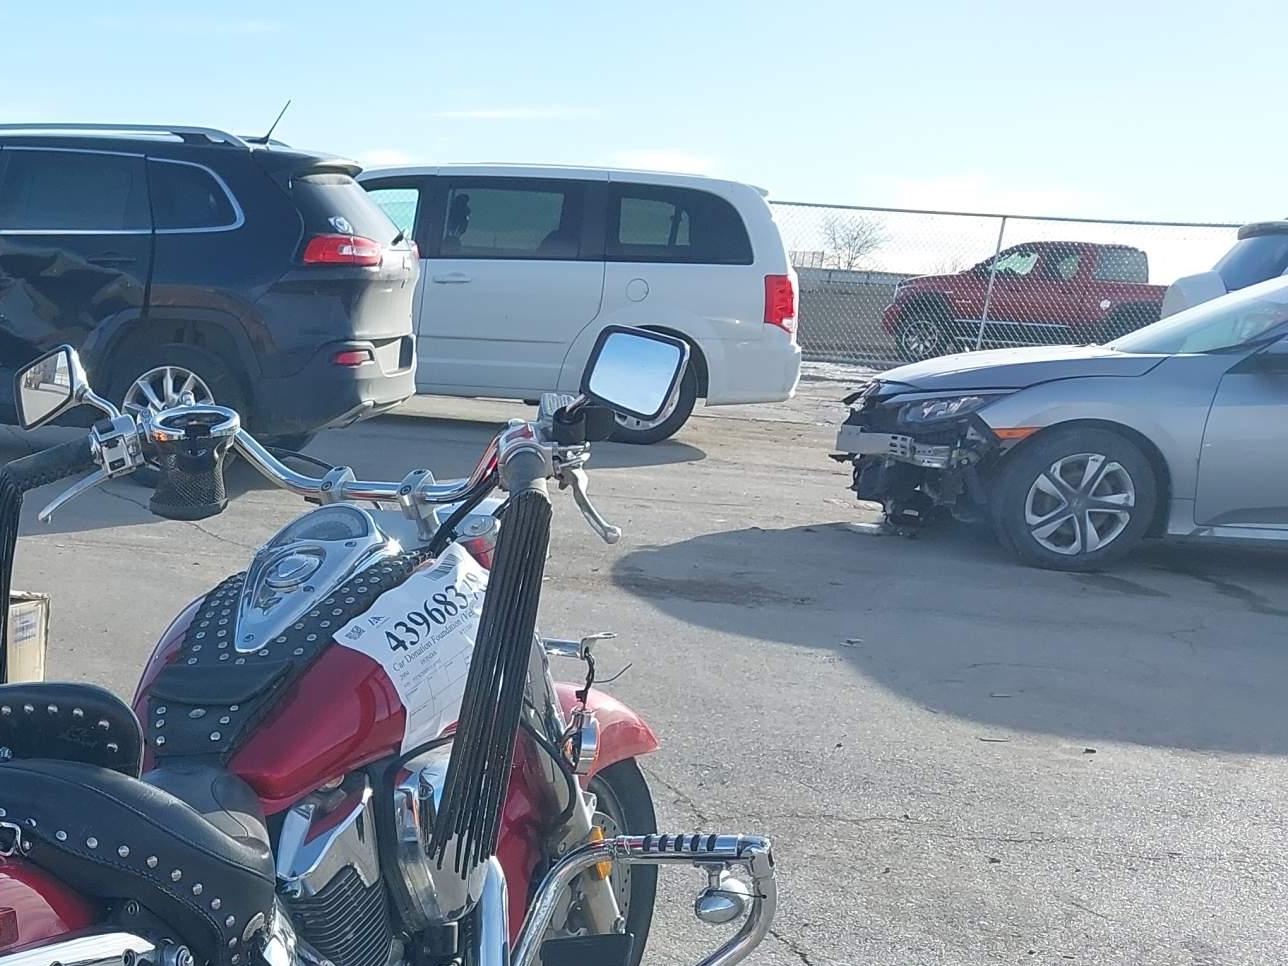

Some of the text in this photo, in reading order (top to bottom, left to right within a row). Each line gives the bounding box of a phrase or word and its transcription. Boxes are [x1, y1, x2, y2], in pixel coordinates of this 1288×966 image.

[392, 656, 406, 672] Car
[404, 640, 432, 663] Donation
[431, 619, 462, 645] Foundation
